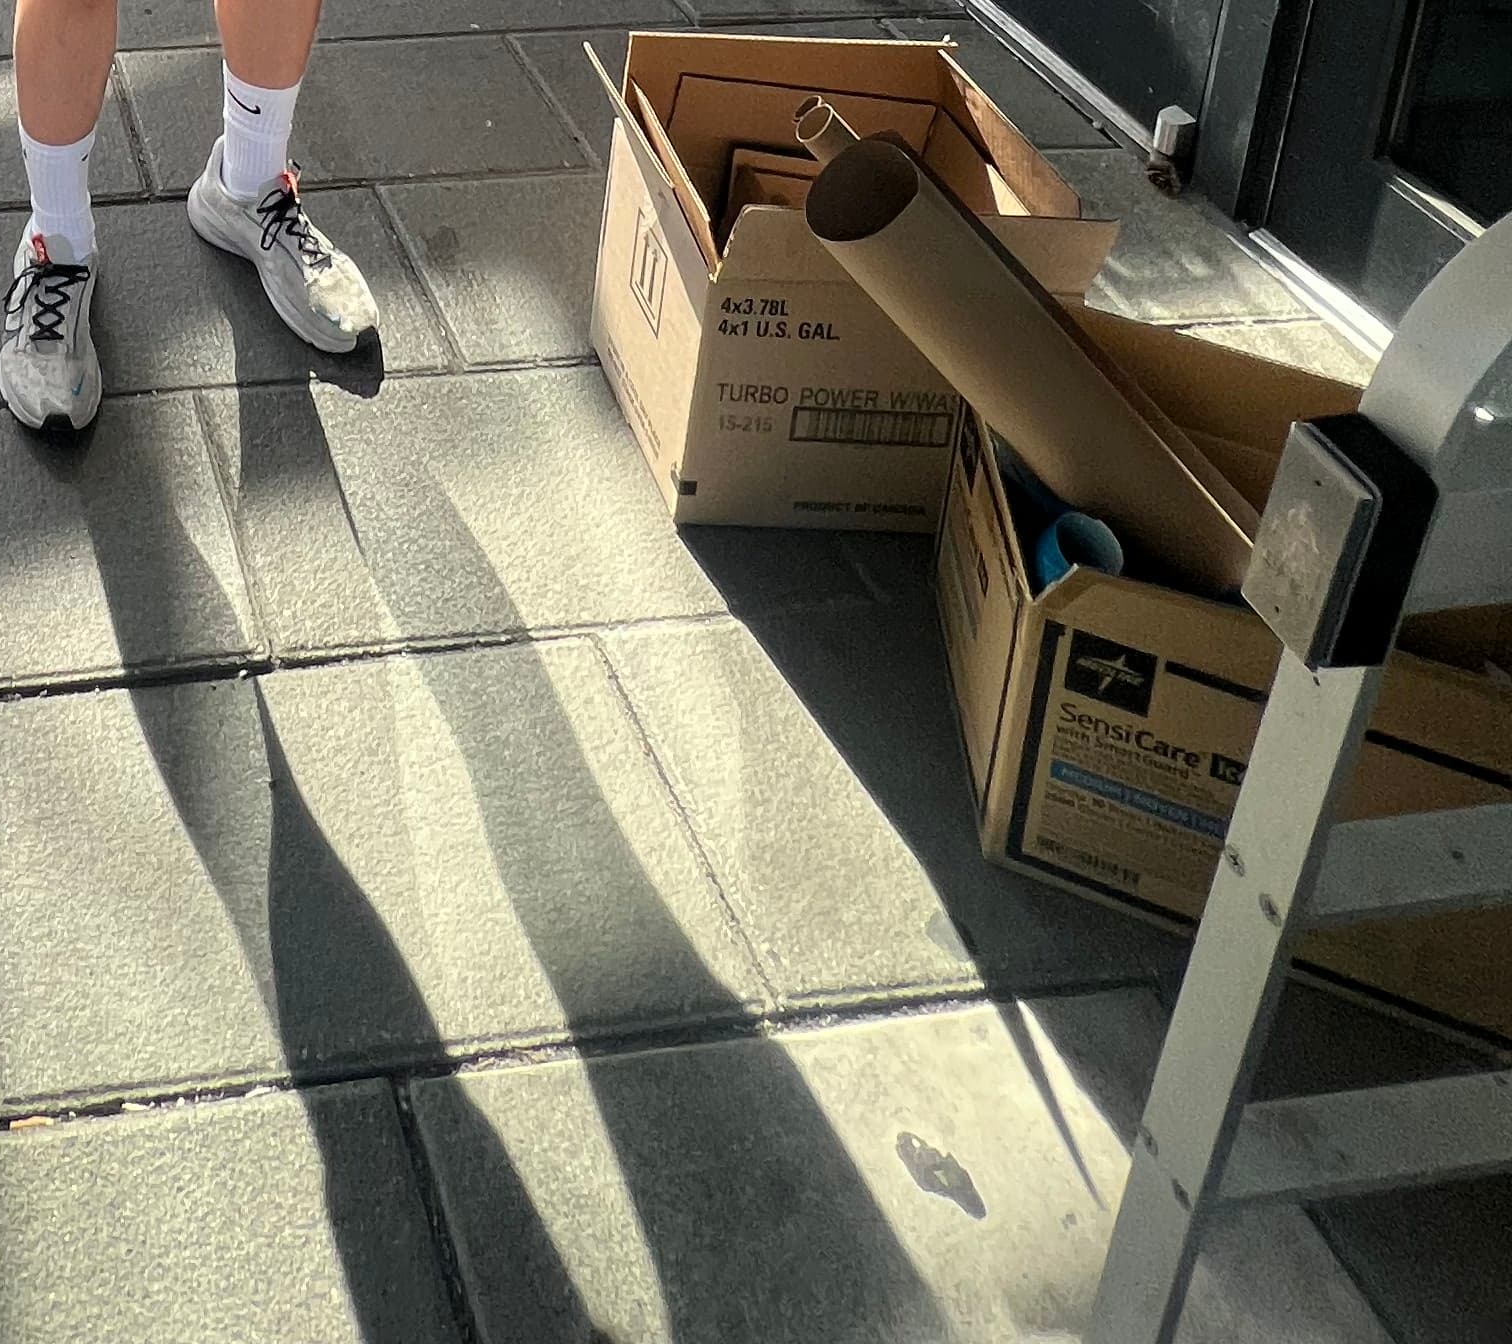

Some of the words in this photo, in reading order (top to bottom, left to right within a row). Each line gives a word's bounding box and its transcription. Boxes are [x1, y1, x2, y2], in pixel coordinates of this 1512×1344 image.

[720, 297, 790, 317] 4x3.78L
[718, 319, 749, 337] 4x1
[756, 320, 791, 340] U.S.
[798, 321, 841, 341] GAL
[717, 382, 789, 405] TURBO
[799, 386, 881, 410] POWER
[1056, 723, 1090, 744] with
[1059, 701, 1201, 768] SensiCare
